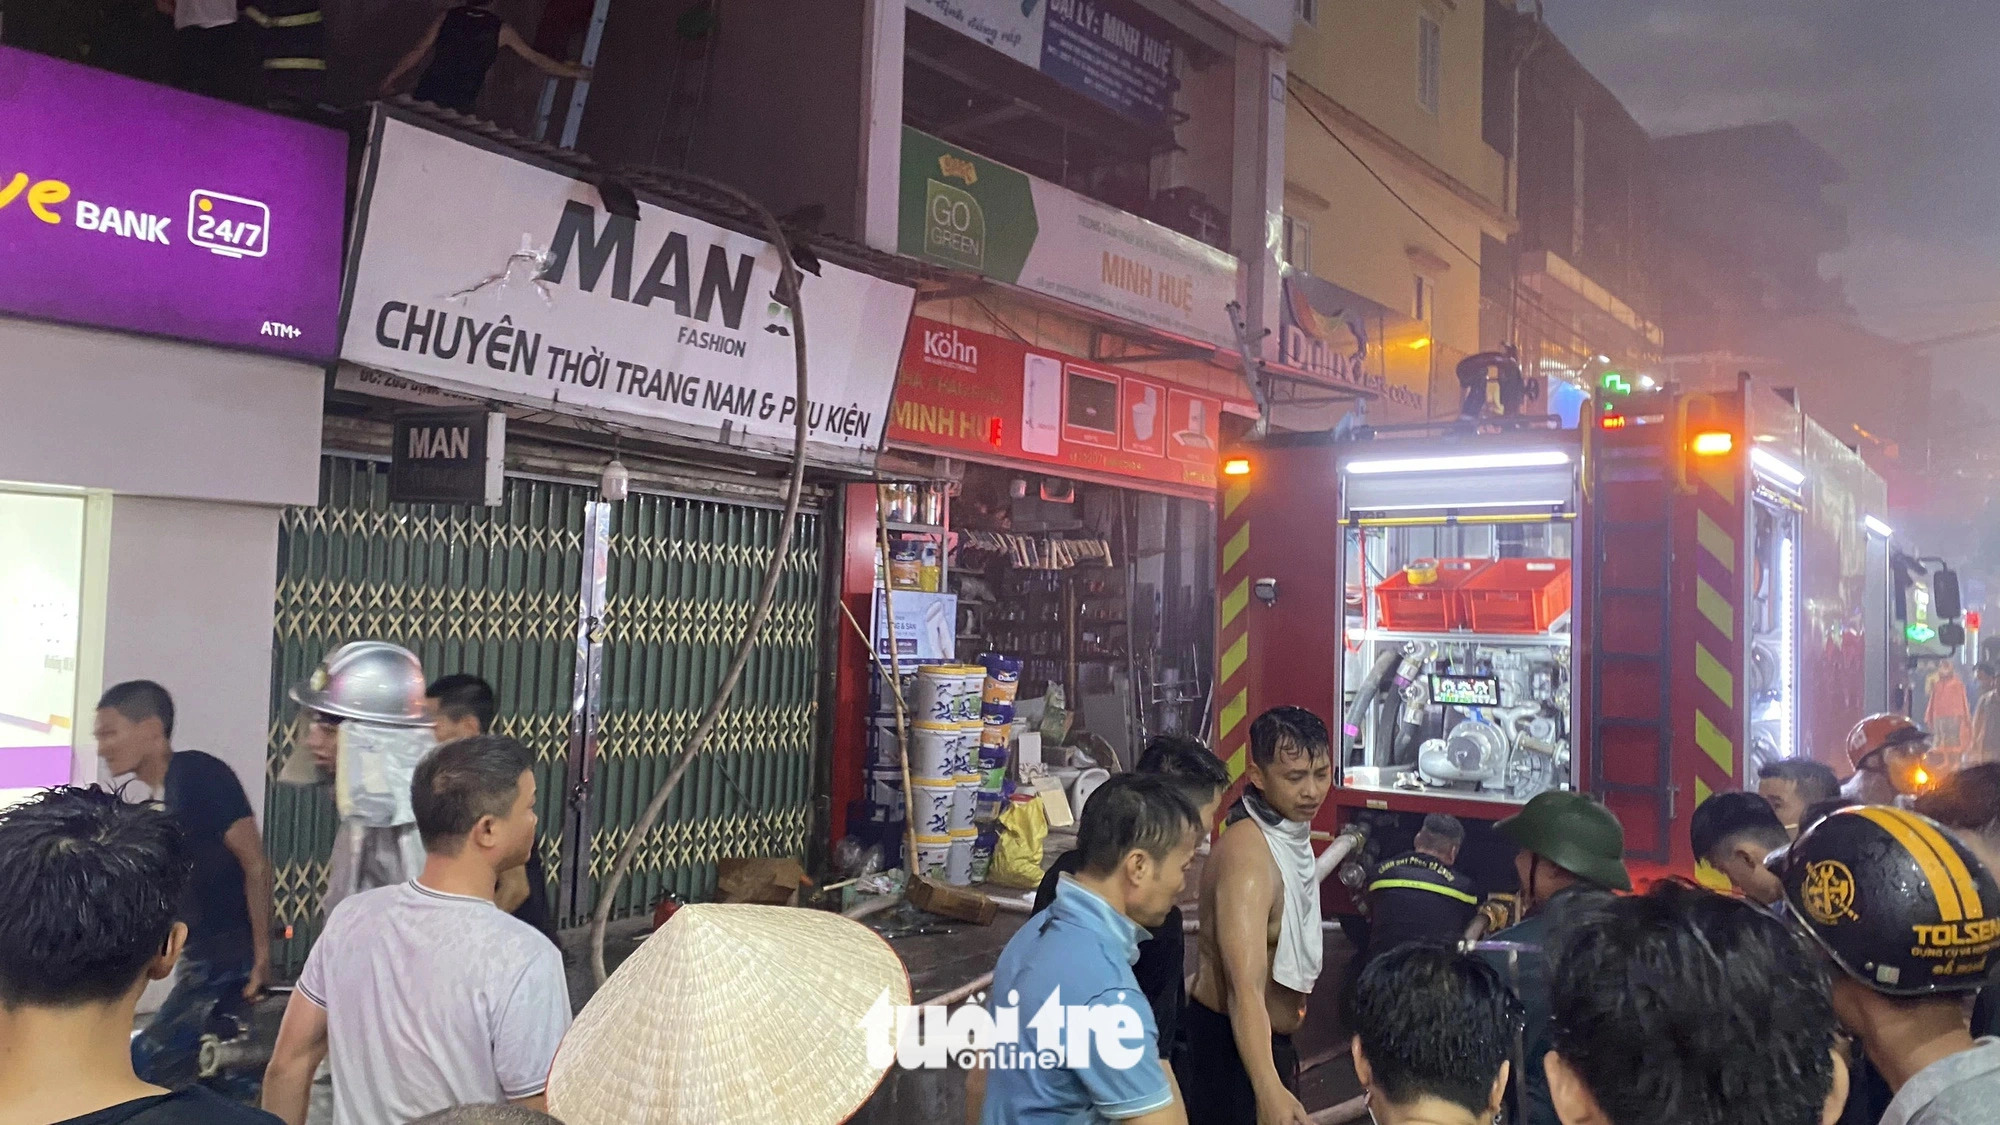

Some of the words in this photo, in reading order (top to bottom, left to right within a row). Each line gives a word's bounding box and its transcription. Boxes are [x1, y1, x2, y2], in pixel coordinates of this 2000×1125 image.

[1102, 11, 1141, 57] MINH
[75, 200, 171, 245] BANK
[197, 214, 262, 247] 24/7
[933, 195, 970, 231] GO
[930, 226, 979, 256] GREEN
[538, 199, 755, 330] MAN
[1101, 250, 1153, 298] MINH
[260, 320, 301, 340] ATM+
[677, 326, 747, 359] FASHION
[924, 329, 978, 366] Köhn
[375, 300, 541, 376] CHUYÊN
[547, 345, 611, 389] THỜI
[616, 361, 701, 407] TRANG
[702, 380, 757, 418] NAM
[758, 392, 776, 419] &
[825, 402, 872, 442] KIỆN
[408, 427, 470, 459] MAN
